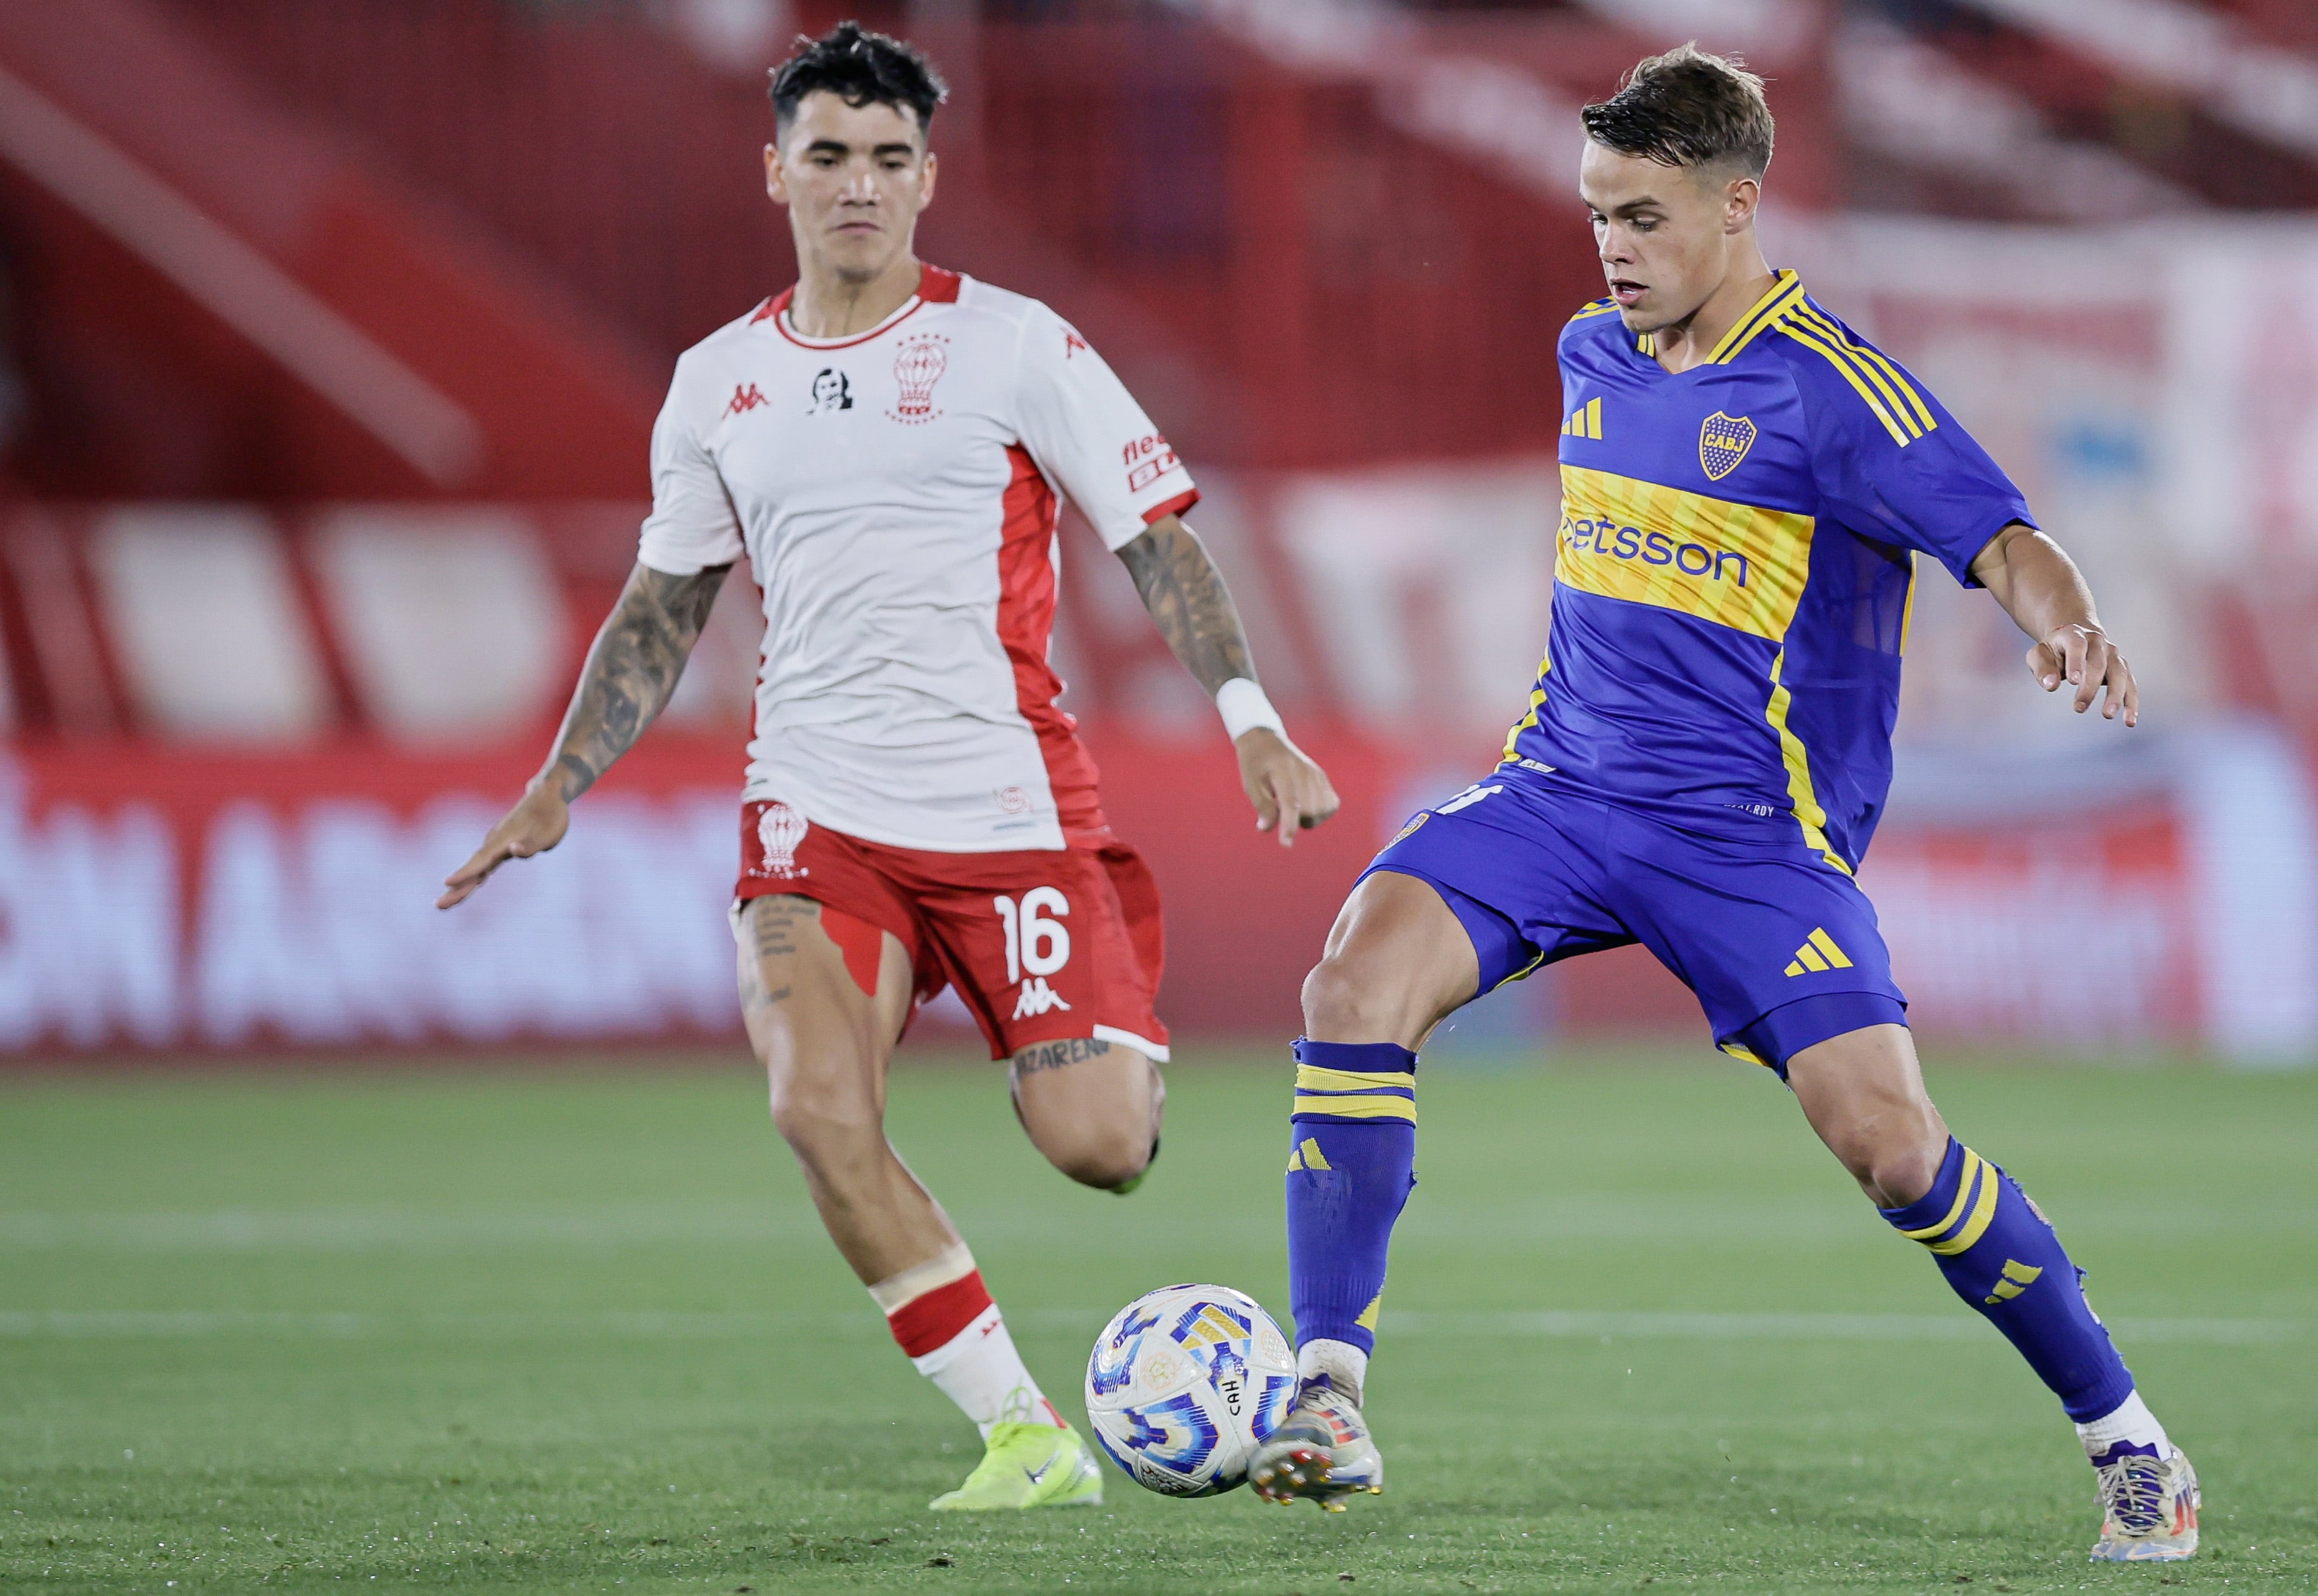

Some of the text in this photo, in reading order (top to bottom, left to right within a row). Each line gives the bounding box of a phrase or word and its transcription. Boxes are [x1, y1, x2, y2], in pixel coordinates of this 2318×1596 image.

[1704, 433, 1746, 452] CABJ
[993, 885, 1071, 984] 16
[1221, 1380, 1241, 1416] CAH
